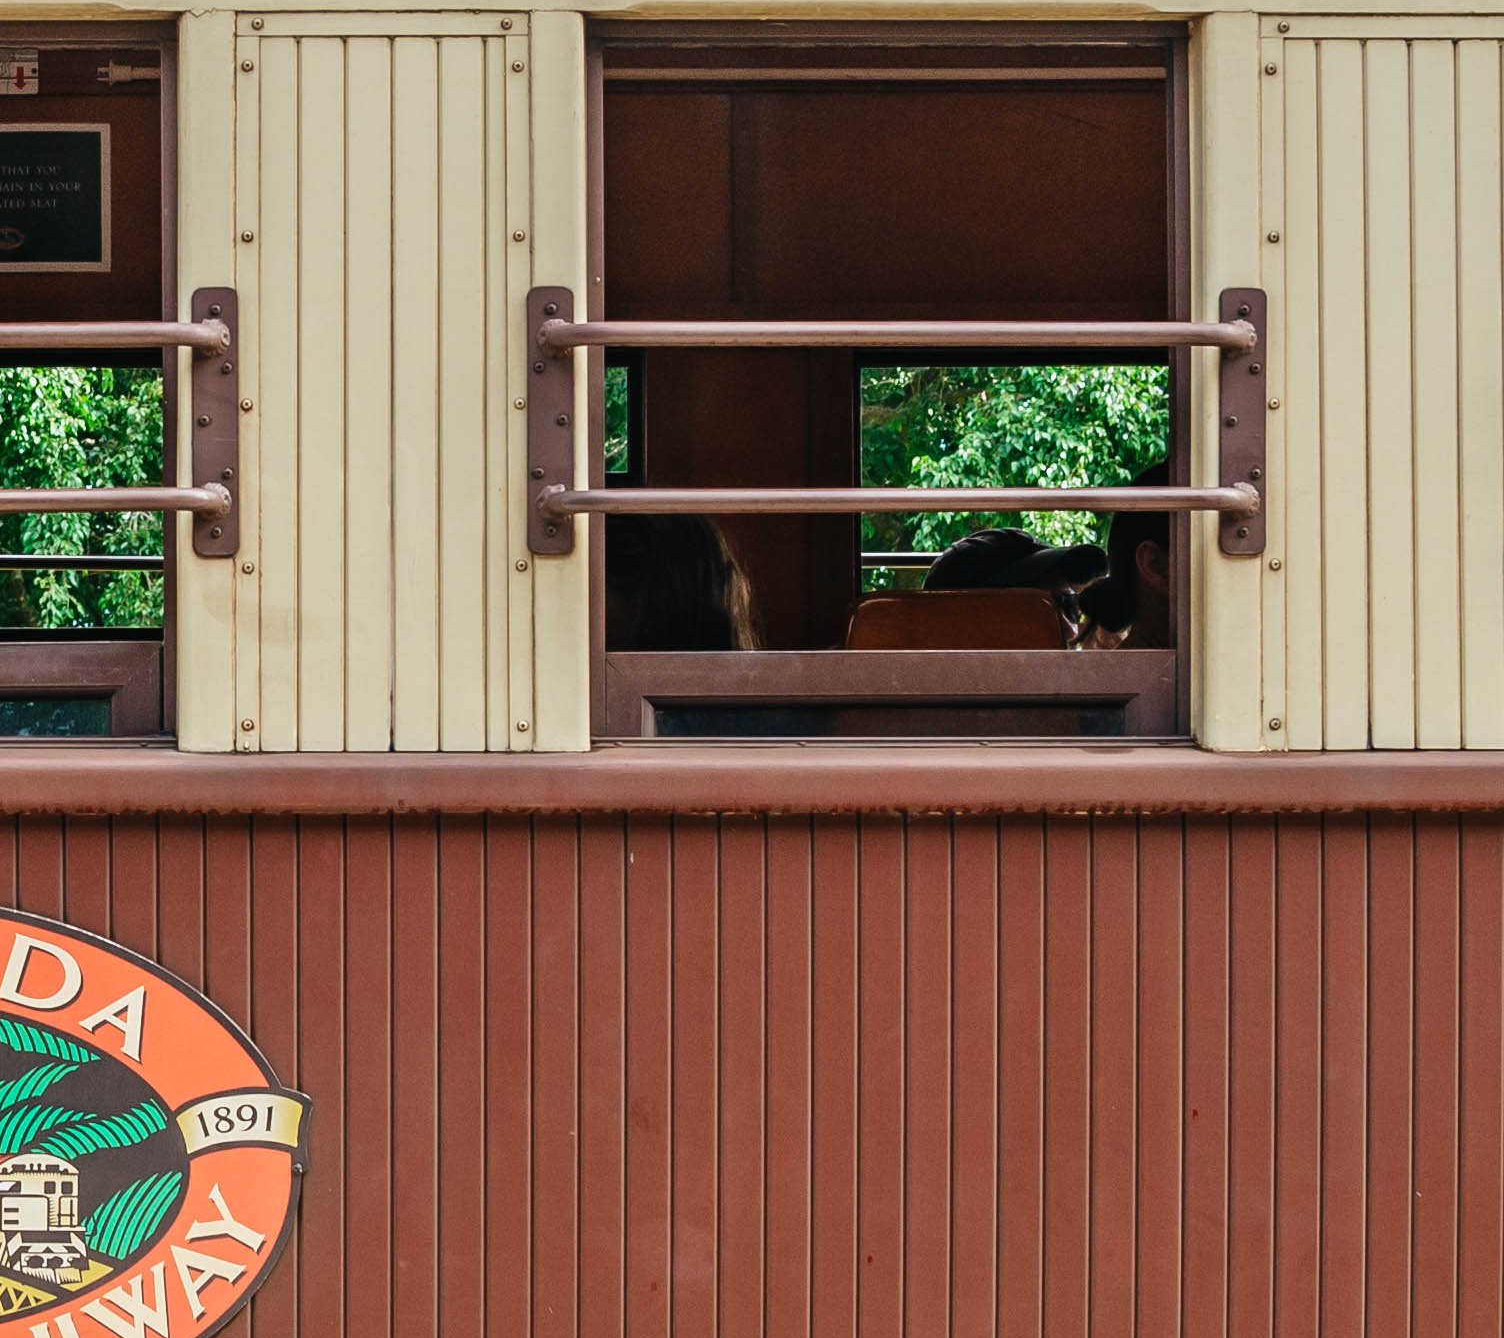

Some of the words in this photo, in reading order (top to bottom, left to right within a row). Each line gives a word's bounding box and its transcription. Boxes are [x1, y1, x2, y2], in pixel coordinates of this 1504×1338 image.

[1, 164, 30, 176] THAT
[48, 180, 81, 192] YOUR
[196, 1105, 277, 1140] 1891
